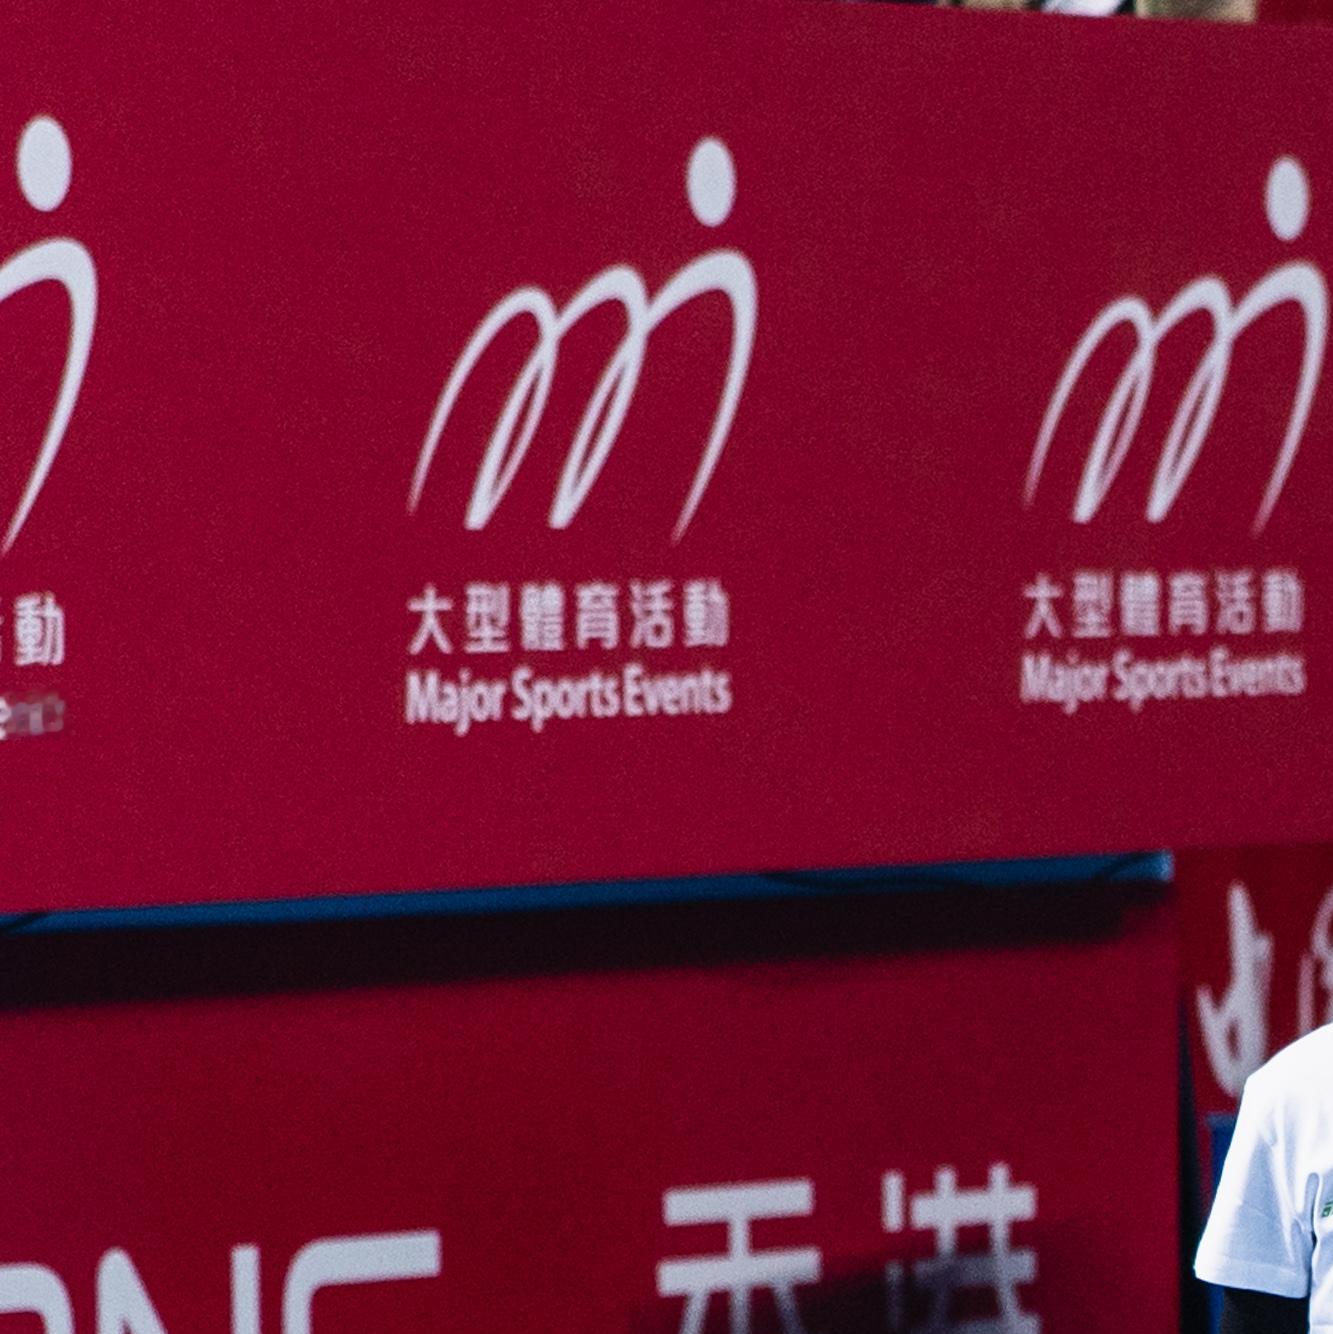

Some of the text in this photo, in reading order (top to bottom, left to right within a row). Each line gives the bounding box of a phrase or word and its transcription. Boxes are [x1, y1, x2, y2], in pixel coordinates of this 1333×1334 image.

[406, 578, 731, 655] 大型體育活動
[1022, 569, 1305, 639] 大型體育活動
[404, 661, 733, 738] Major Sports Events
[1019, 645, 1308, 715] Major Sports Events
